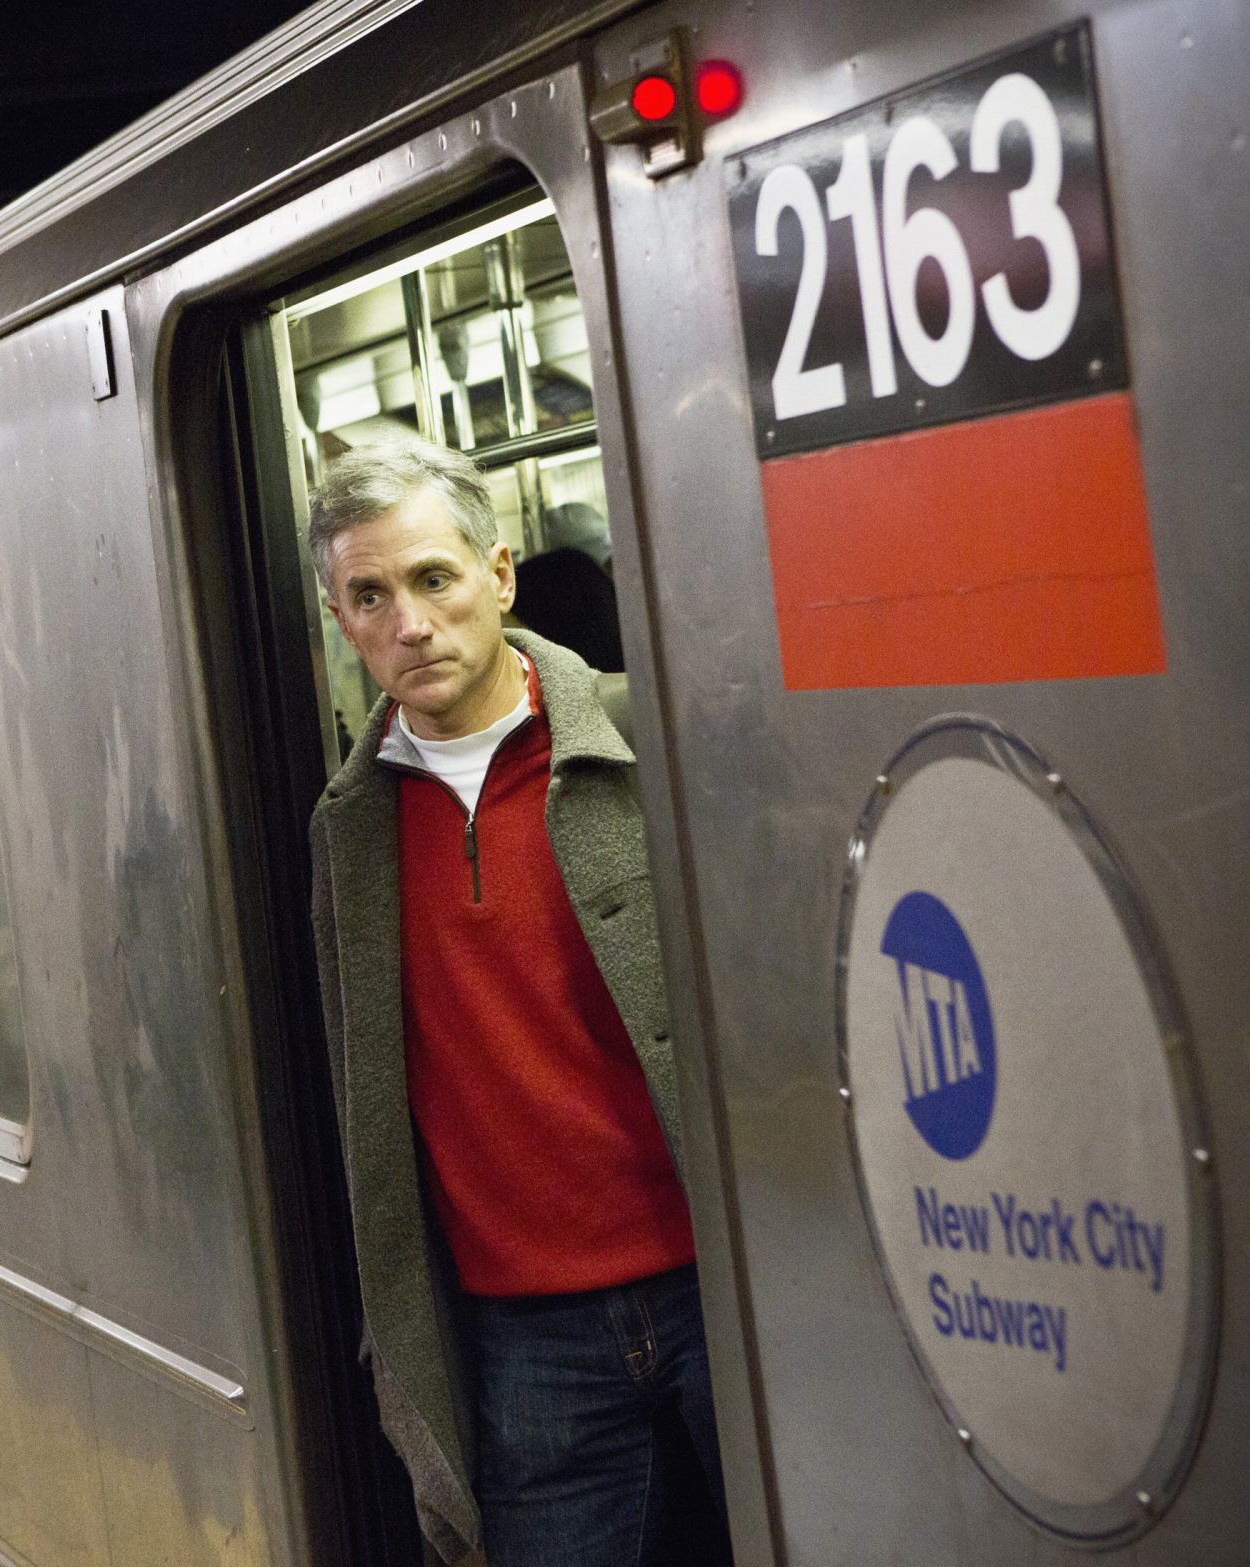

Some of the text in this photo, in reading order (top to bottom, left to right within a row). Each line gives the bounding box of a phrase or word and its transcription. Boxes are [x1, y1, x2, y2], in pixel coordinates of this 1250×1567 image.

[755, 72, 1081, 421] 2163
[893, 958, 982, 1100] MTA
[913, 1186, 1165, 1292] New York City
[928, 1272, 1067, 1372] Subway
